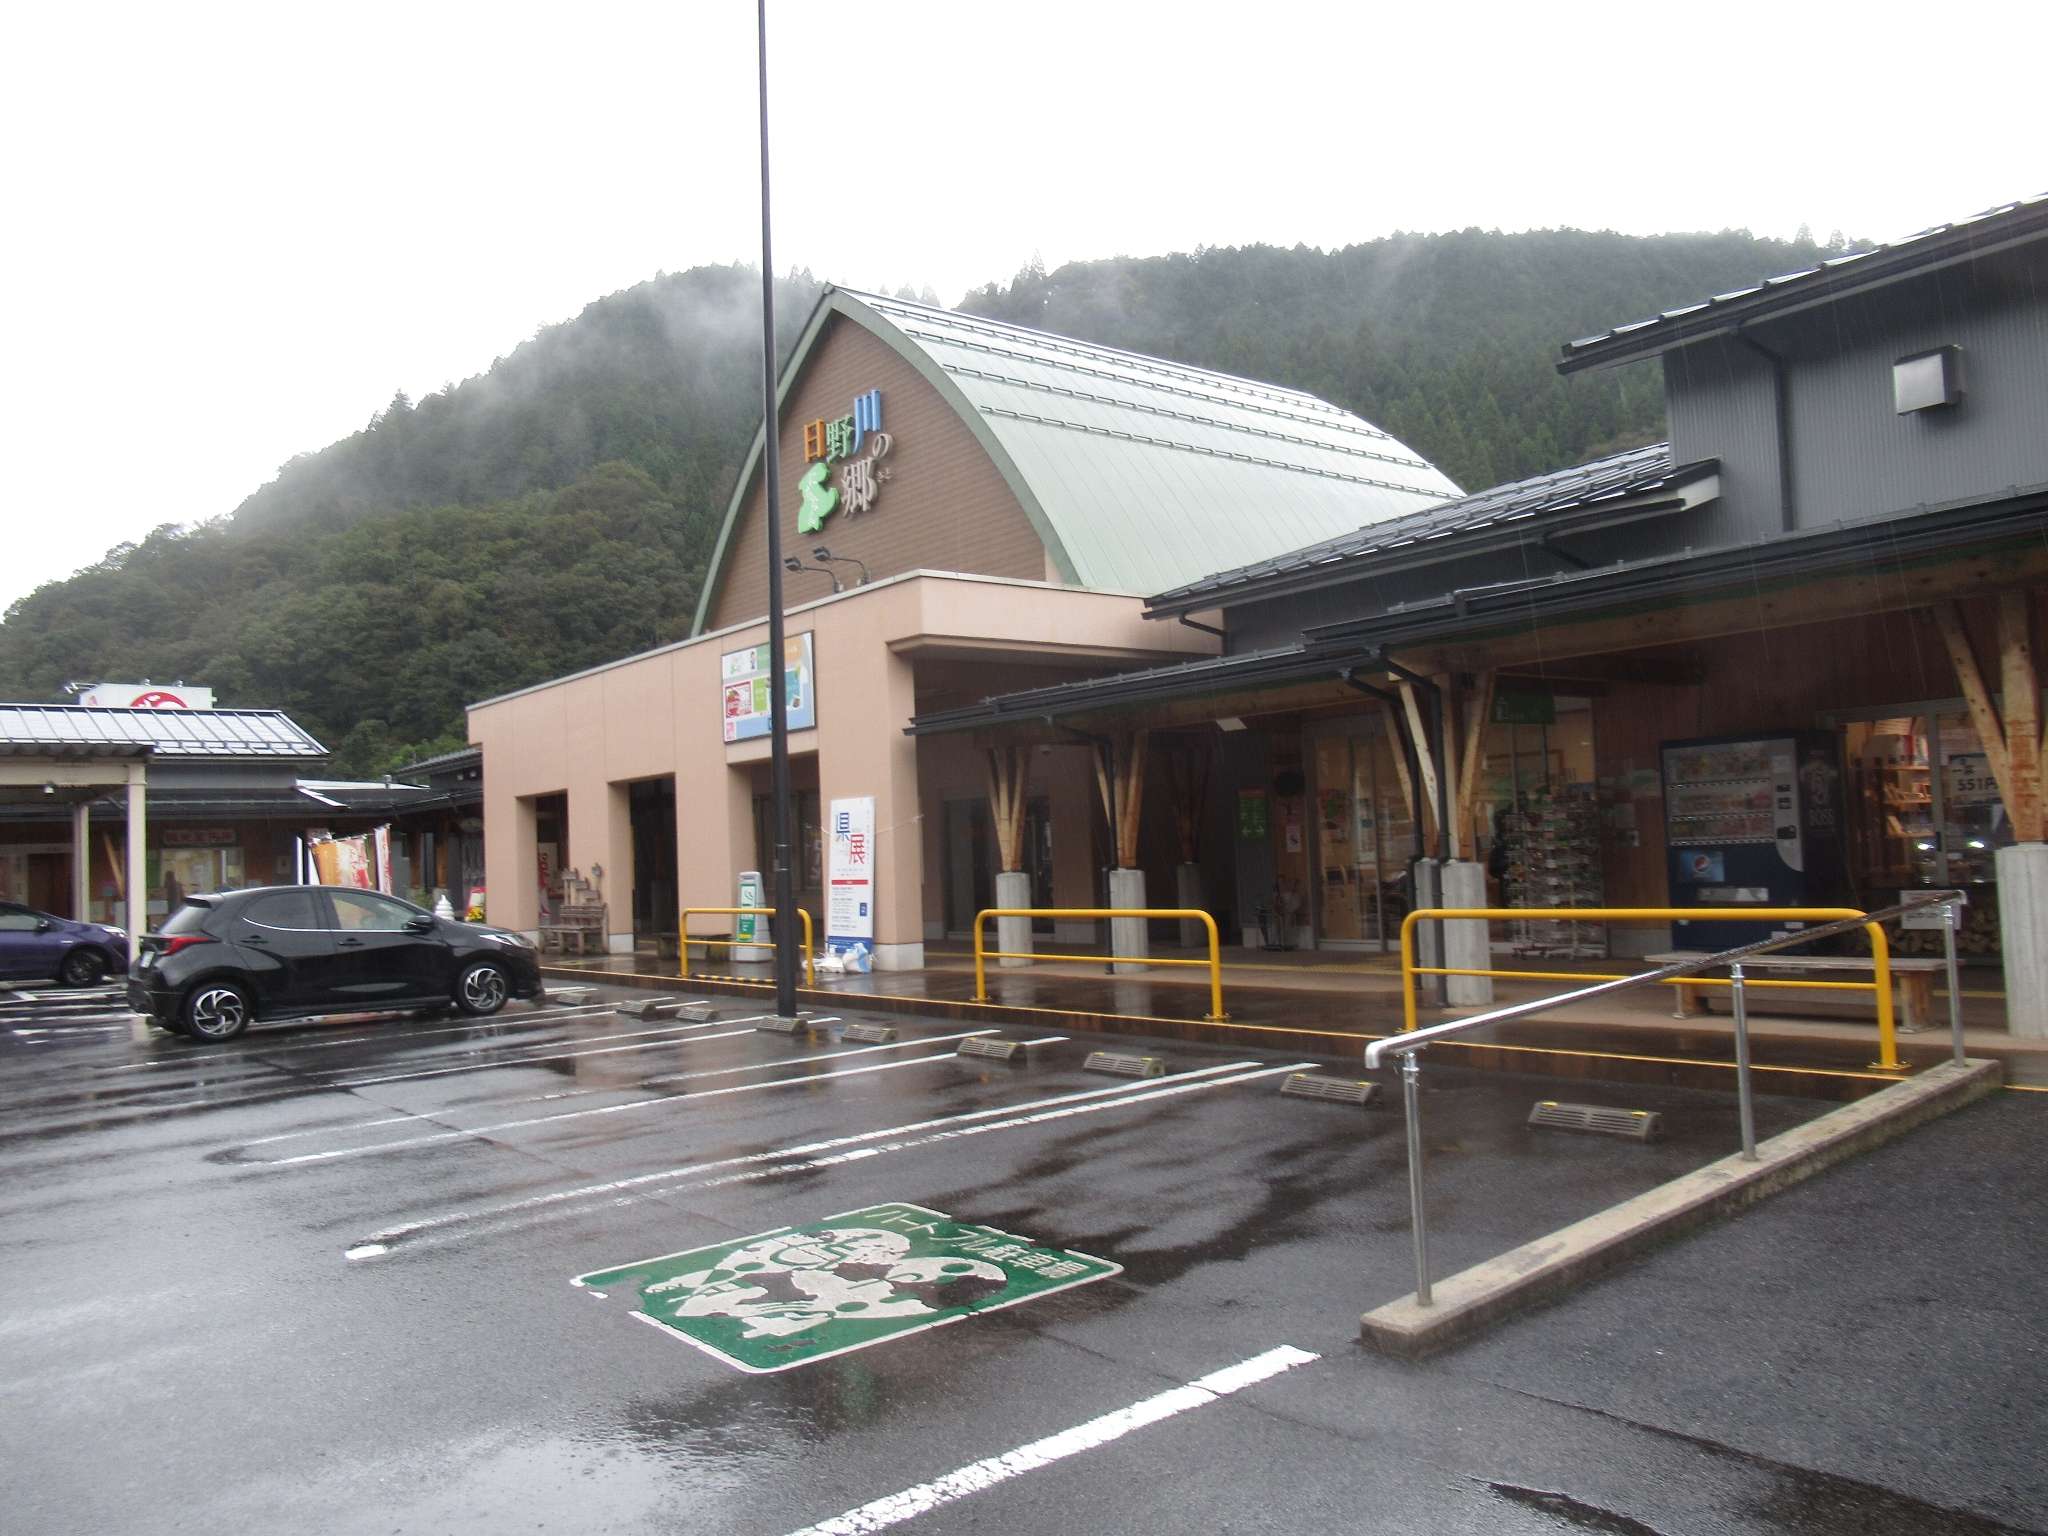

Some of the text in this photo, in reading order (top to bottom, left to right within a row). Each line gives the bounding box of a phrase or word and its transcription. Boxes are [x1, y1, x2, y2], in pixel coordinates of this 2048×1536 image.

[866, 1209, 1090, 1278] ハートフル駐車場
